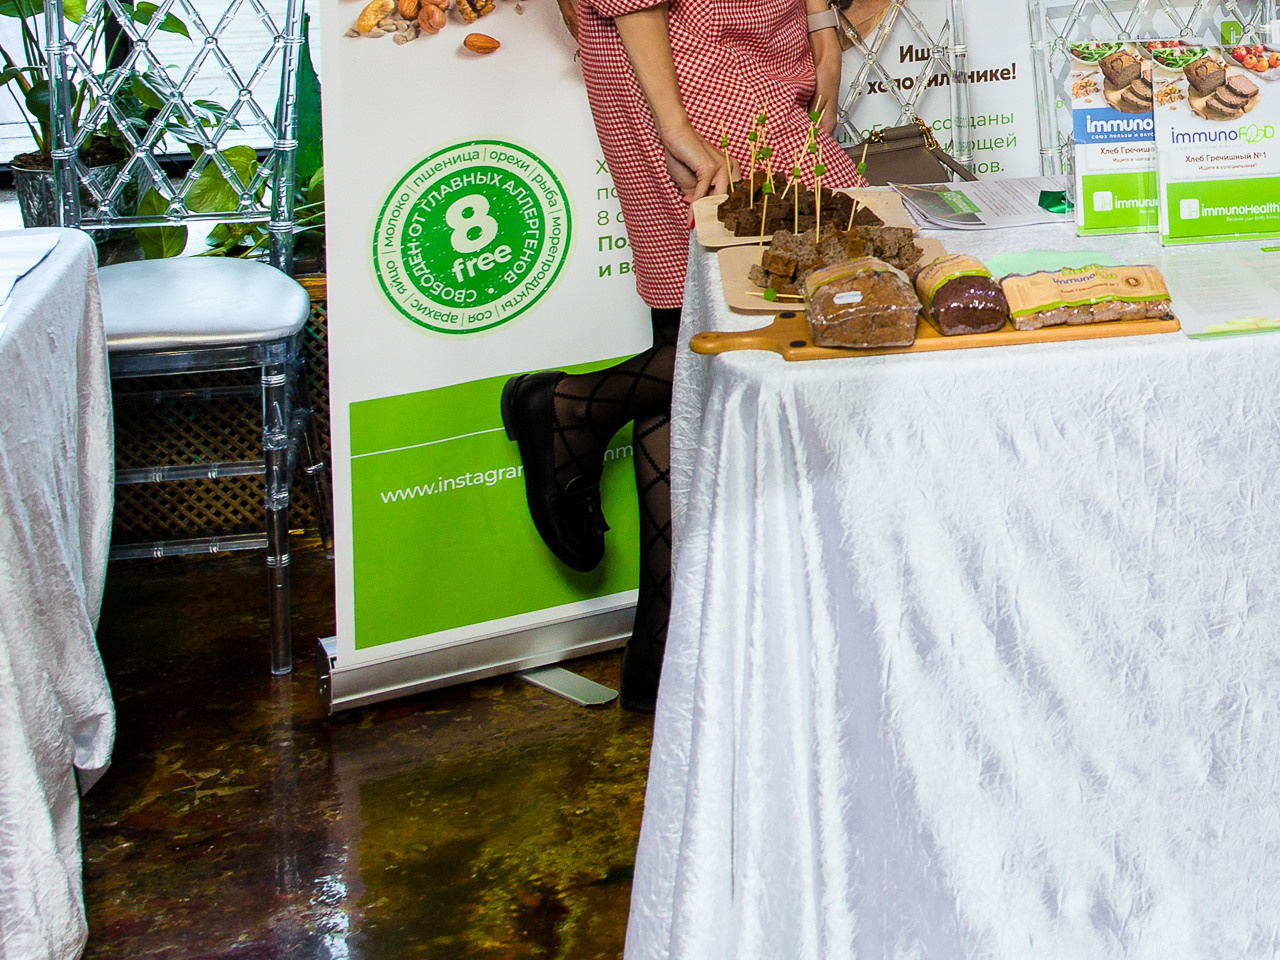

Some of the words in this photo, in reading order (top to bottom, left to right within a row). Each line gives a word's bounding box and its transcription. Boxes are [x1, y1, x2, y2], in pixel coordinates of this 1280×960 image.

[412, 151, 479, 187] пшеница
[490, 151, 530, 171] орехи
[1186, 155, 1204, 163] Хлеб
[1206, 152, 1251, 162] Гречишный
[422, 172, 503, 212] ГЛАВНЫХ
[532, 174, 557, 207] рыба
[384, 193, 409, 246] молоко
[409, 213, 426, 236] ОТ
[446, 194, 498, 253] 8
[1201, 202, 1280, 216] immunoHealth
[503, 180, 539, 284] АЛЛЕРГЕНОВ
[387, 261, 407, 294] яйцо
[409, 241, 477, 302] СВОБОДЕН
[452, 245, 512, 282] free
[502, 217, 561, 311] морепродукты
[410, 300, 458, 323] арахис
[468, 310, 492, 322] соя
[381, 465, 523, 503] www.instagra
